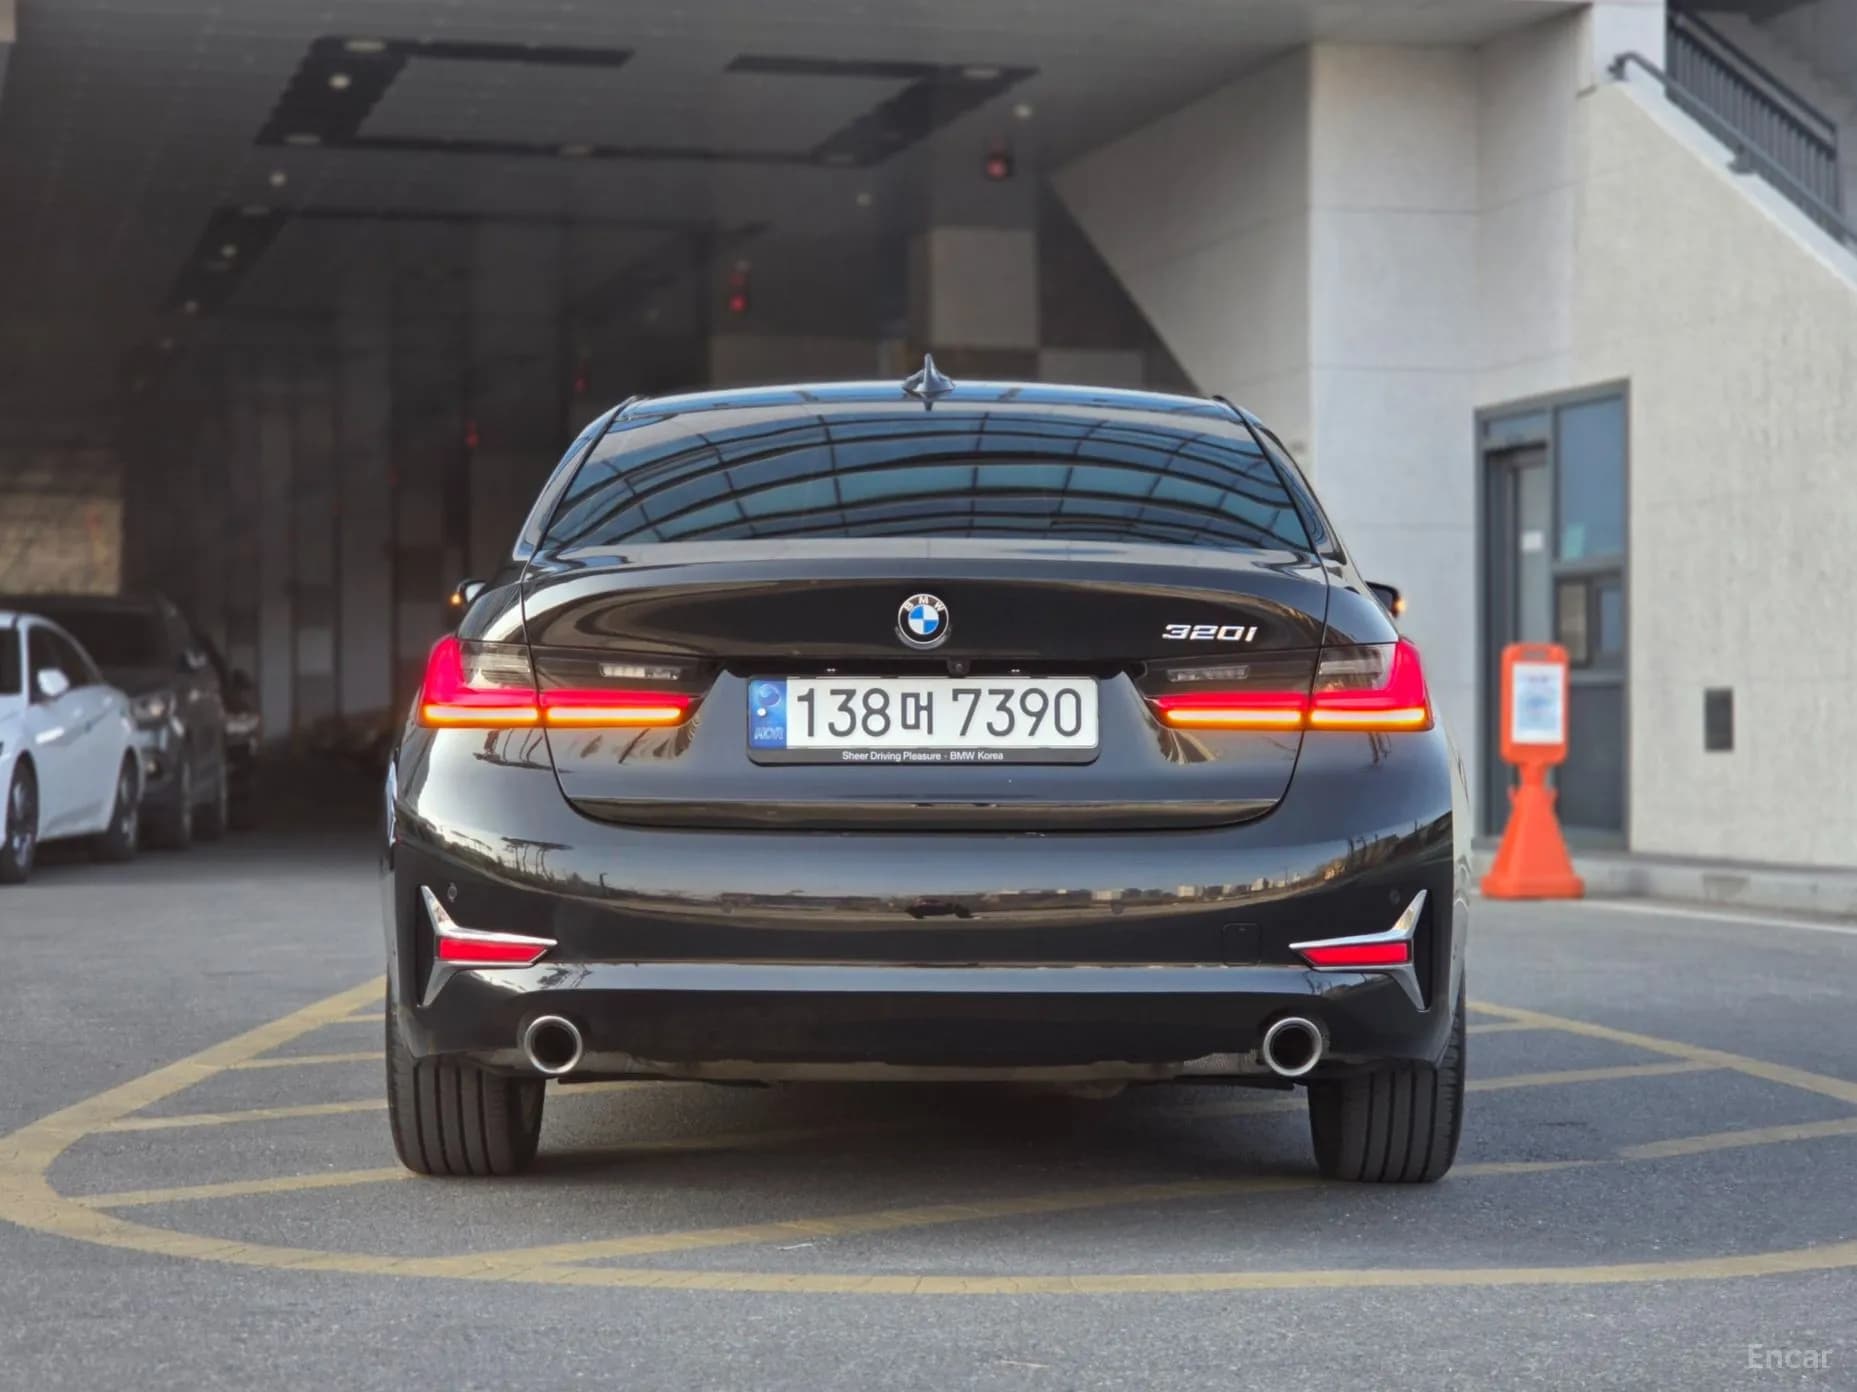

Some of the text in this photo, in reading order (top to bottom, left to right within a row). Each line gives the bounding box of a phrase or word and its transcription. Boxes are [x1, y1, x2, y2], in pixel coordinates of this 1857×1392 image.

[902, 595, 946, 612] BMW
[797, 687, 1082, 737] 138머 7390
[842, 751, 869, 760] Sheer
[870, 751, 901, 762] Driving
[903, 751, 942, 760] Pleasure
[950, 751, 975, 760] BMW
[977, 751, 1004, 760] Korea
